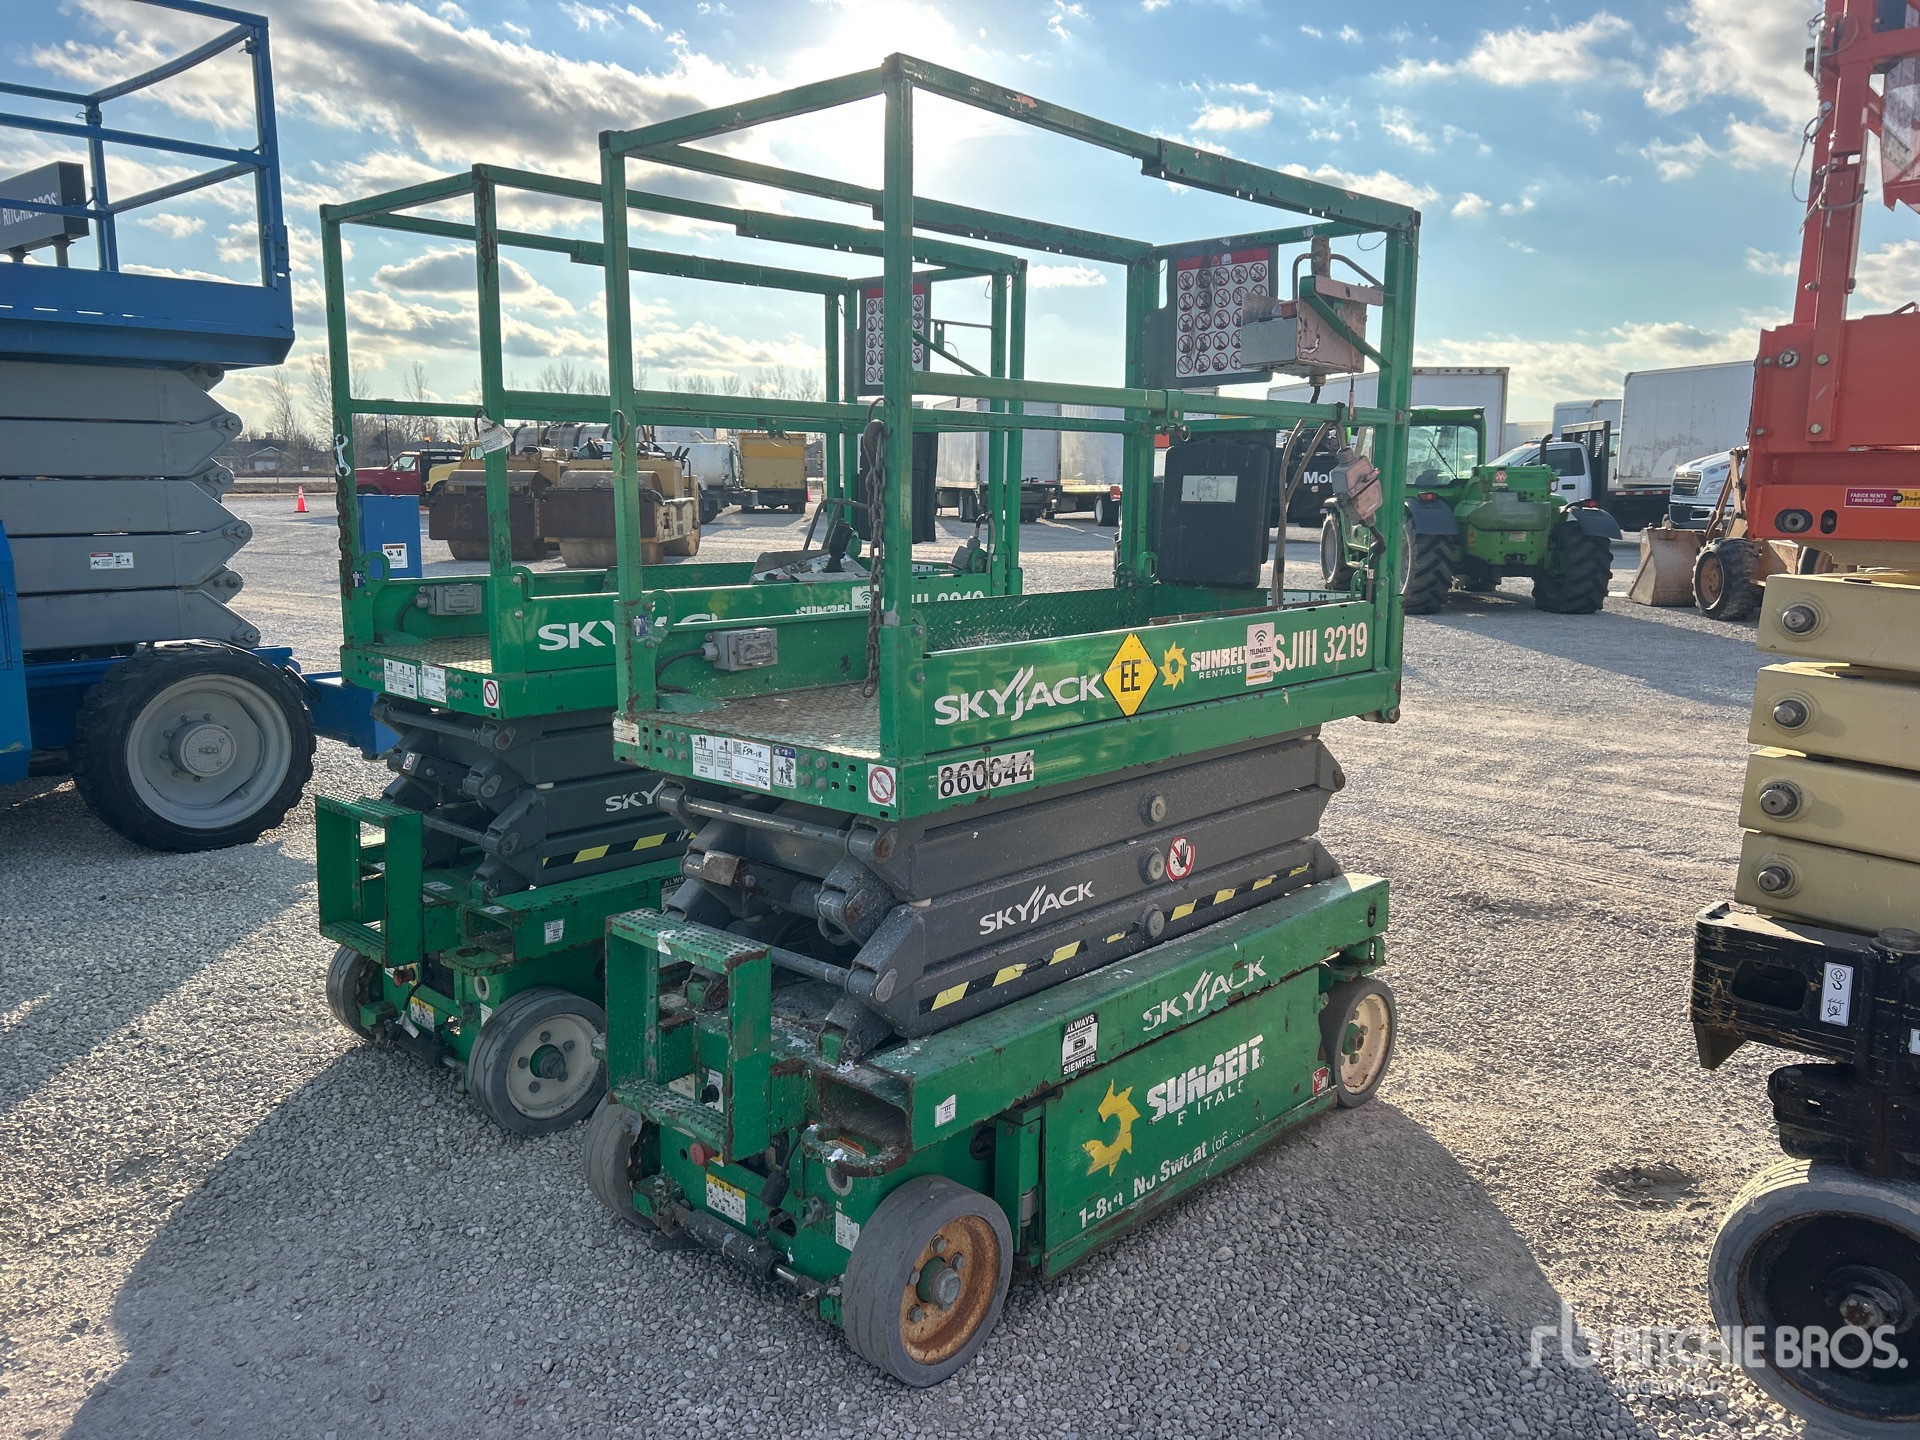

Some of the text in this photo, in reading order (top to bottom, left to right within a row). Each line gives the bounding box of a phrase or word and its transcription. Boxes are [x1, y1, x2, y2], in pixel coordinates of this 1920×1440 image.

[1303, 471, 1332, 484] Mo
[1324, 622, 1368, 664] 3219
[1120, 659, 1142, 693] EE
[1198, 666, 1242, 680] RENTALS
[934, 664, 1105, 725] SKYJACK
[664, 876, 685, 888] ALWA
[980, 880, 1096, 936] SKYJACK
[1142, 955, 1267, 1032] SKYJACK
[1065, 1013, 1095, 1035] ALWAYS
[1063, 1053, 1096, 1075] SIEMPRE
